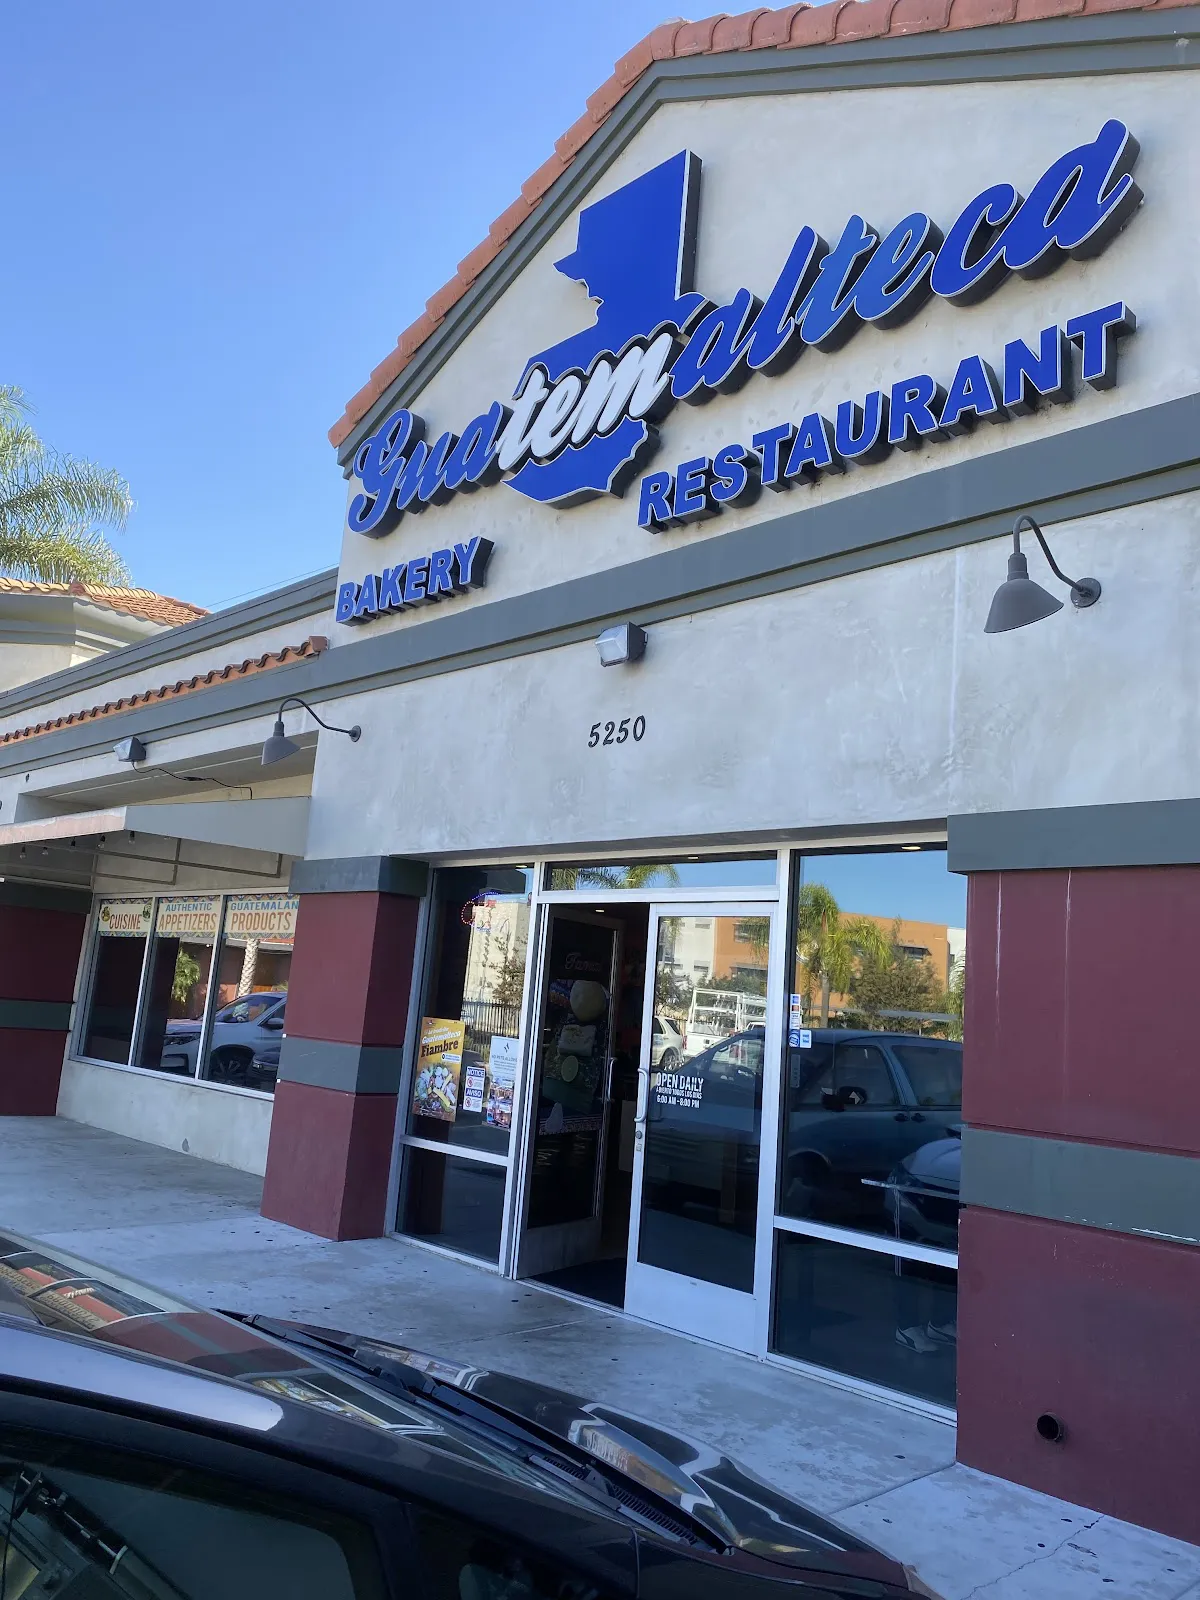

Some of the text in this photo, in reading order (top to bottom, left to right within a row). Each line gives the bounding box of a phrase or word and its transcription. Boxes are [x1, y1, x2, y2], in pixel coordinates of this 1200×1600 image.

[347, 118, 1137, 536] Guatemalteca
[638, 301, 1130, 529] RESTAURANT
[335, 535, 486, 624] BAKERY
[588, 715, 646, 748] 5250
[165, 902, 213, 912] AUTHENTIC
[230, 901, 299, 911] GUATEMALAN
[109, 913, 142, 930] CUISINE
[158, 912, 217, 931] APPETIZERS
[231, 911, 292, 931] PRODUCTS
[420, 1040, 459, 1058] Fiambre
[467, 1069, 485, 1077] NOTICE
[656, 1072, 704, 1092] OPEN DAILY
[466, 1089, 482, 1098] AVISO
[657, 1095, 667, 1103] 6:00
[668, 1096, 677, 1105] AM
[680, 1098, 691, 1107] 8:00
[691, 1100, 699, 1108] PM
